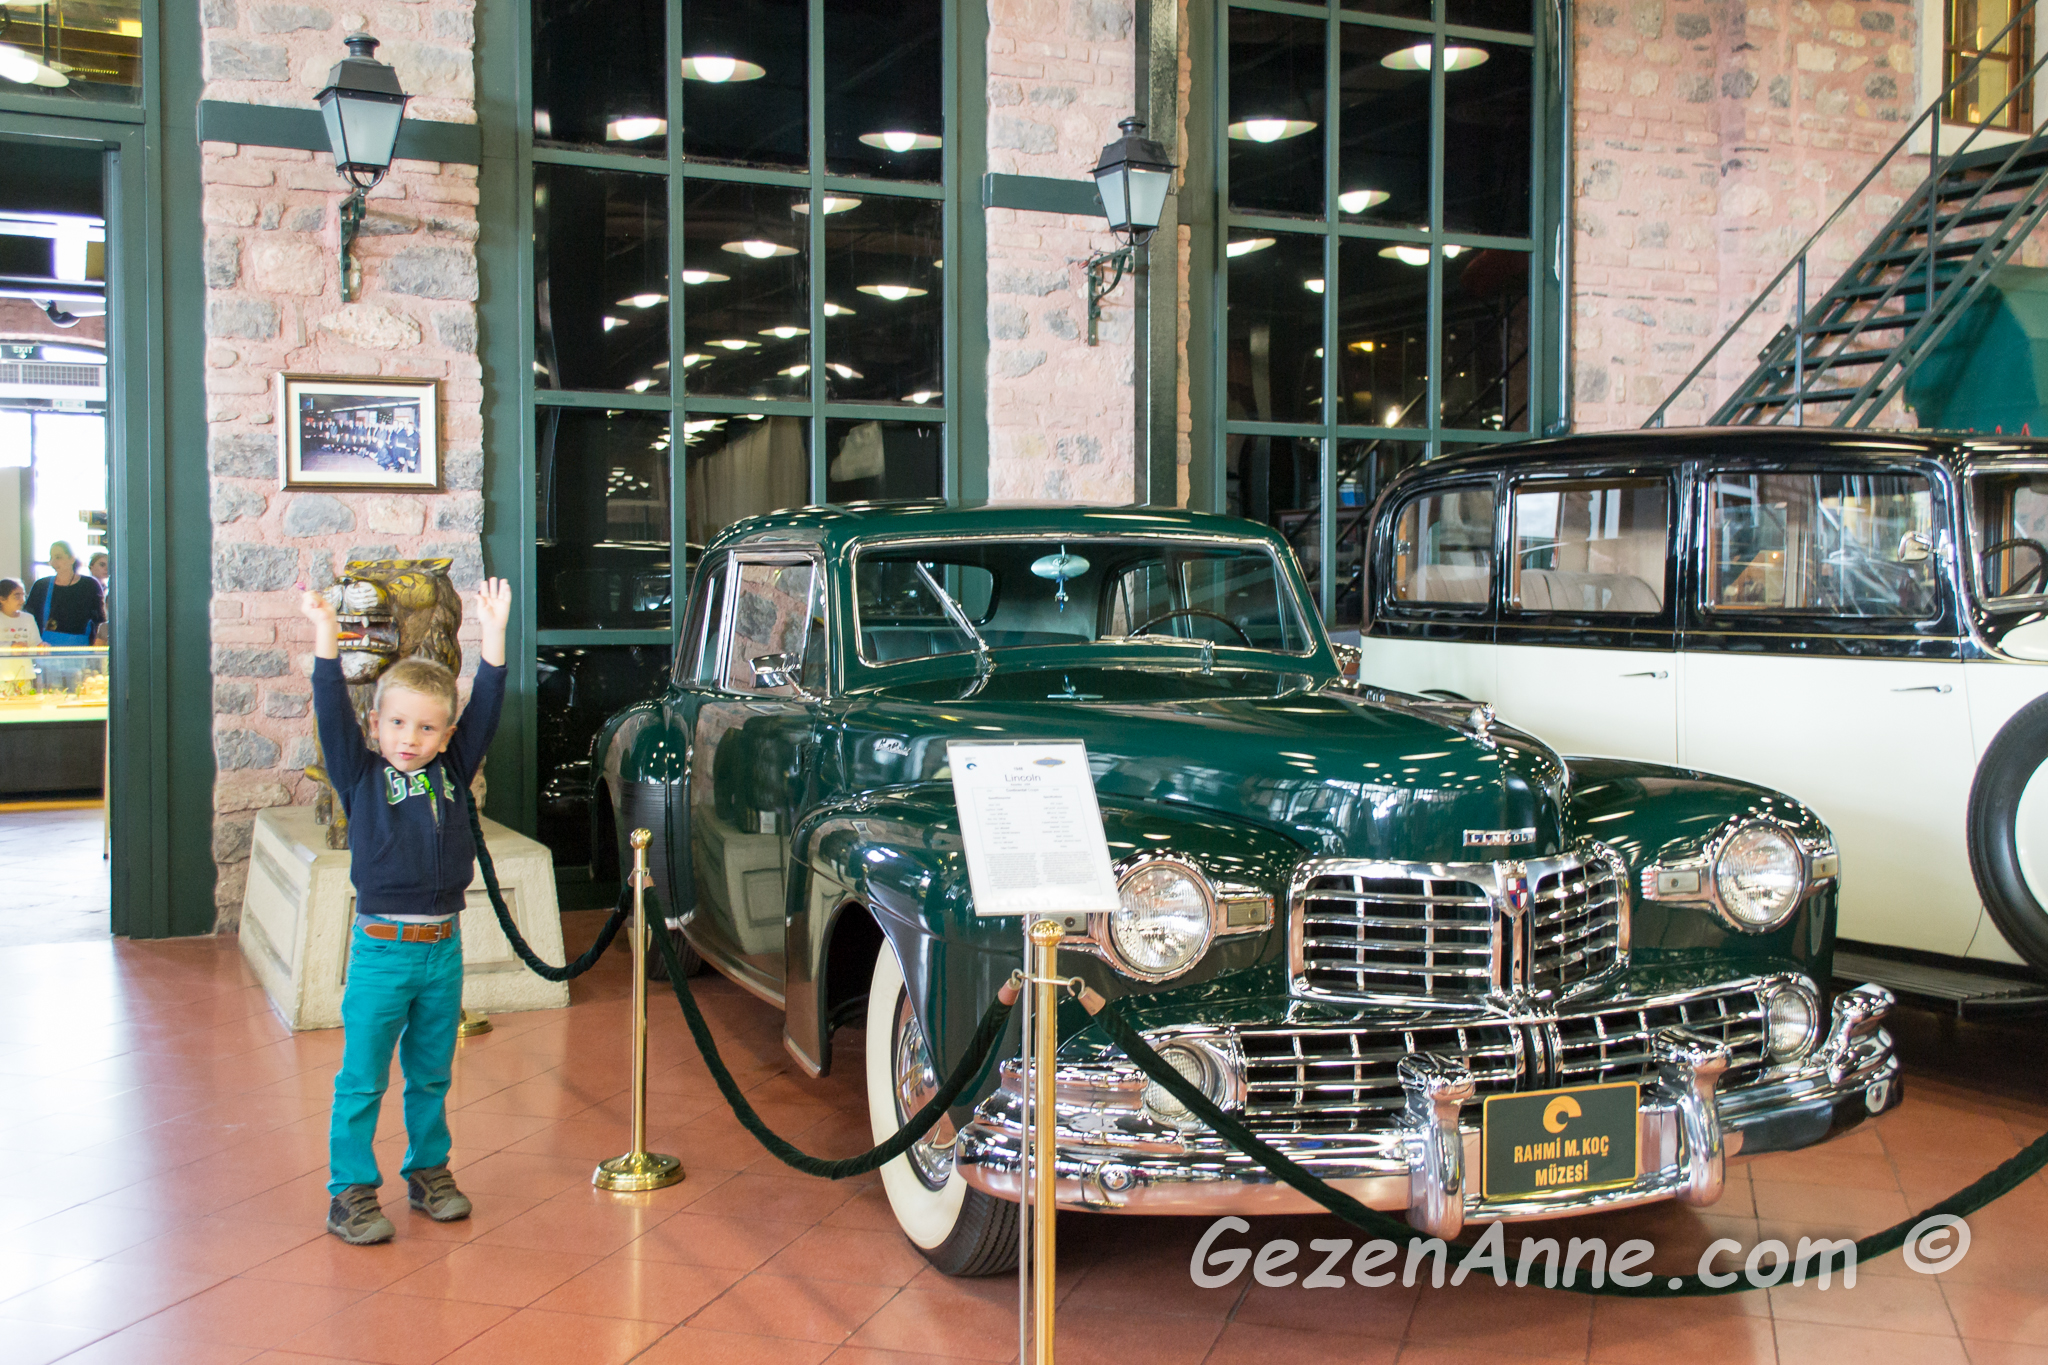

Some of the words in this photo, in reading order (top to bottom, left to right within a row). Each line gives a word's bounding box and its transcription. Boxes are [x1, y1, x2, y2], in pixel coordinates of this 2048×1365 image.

[13, 345, 34, 354] EXIT
[1004, 773, 1042, 782] Lincoln
[1470, 832, 1535, 843] LINCOLN
[1514, 1137, 1561, 1163] RAHMİ
[1564, 1139, 1581, 1158] M.
[1582, 1135, 1610, 1157] KOÇ
[1535, 1159, 1589, 1187] MÜZESİ
